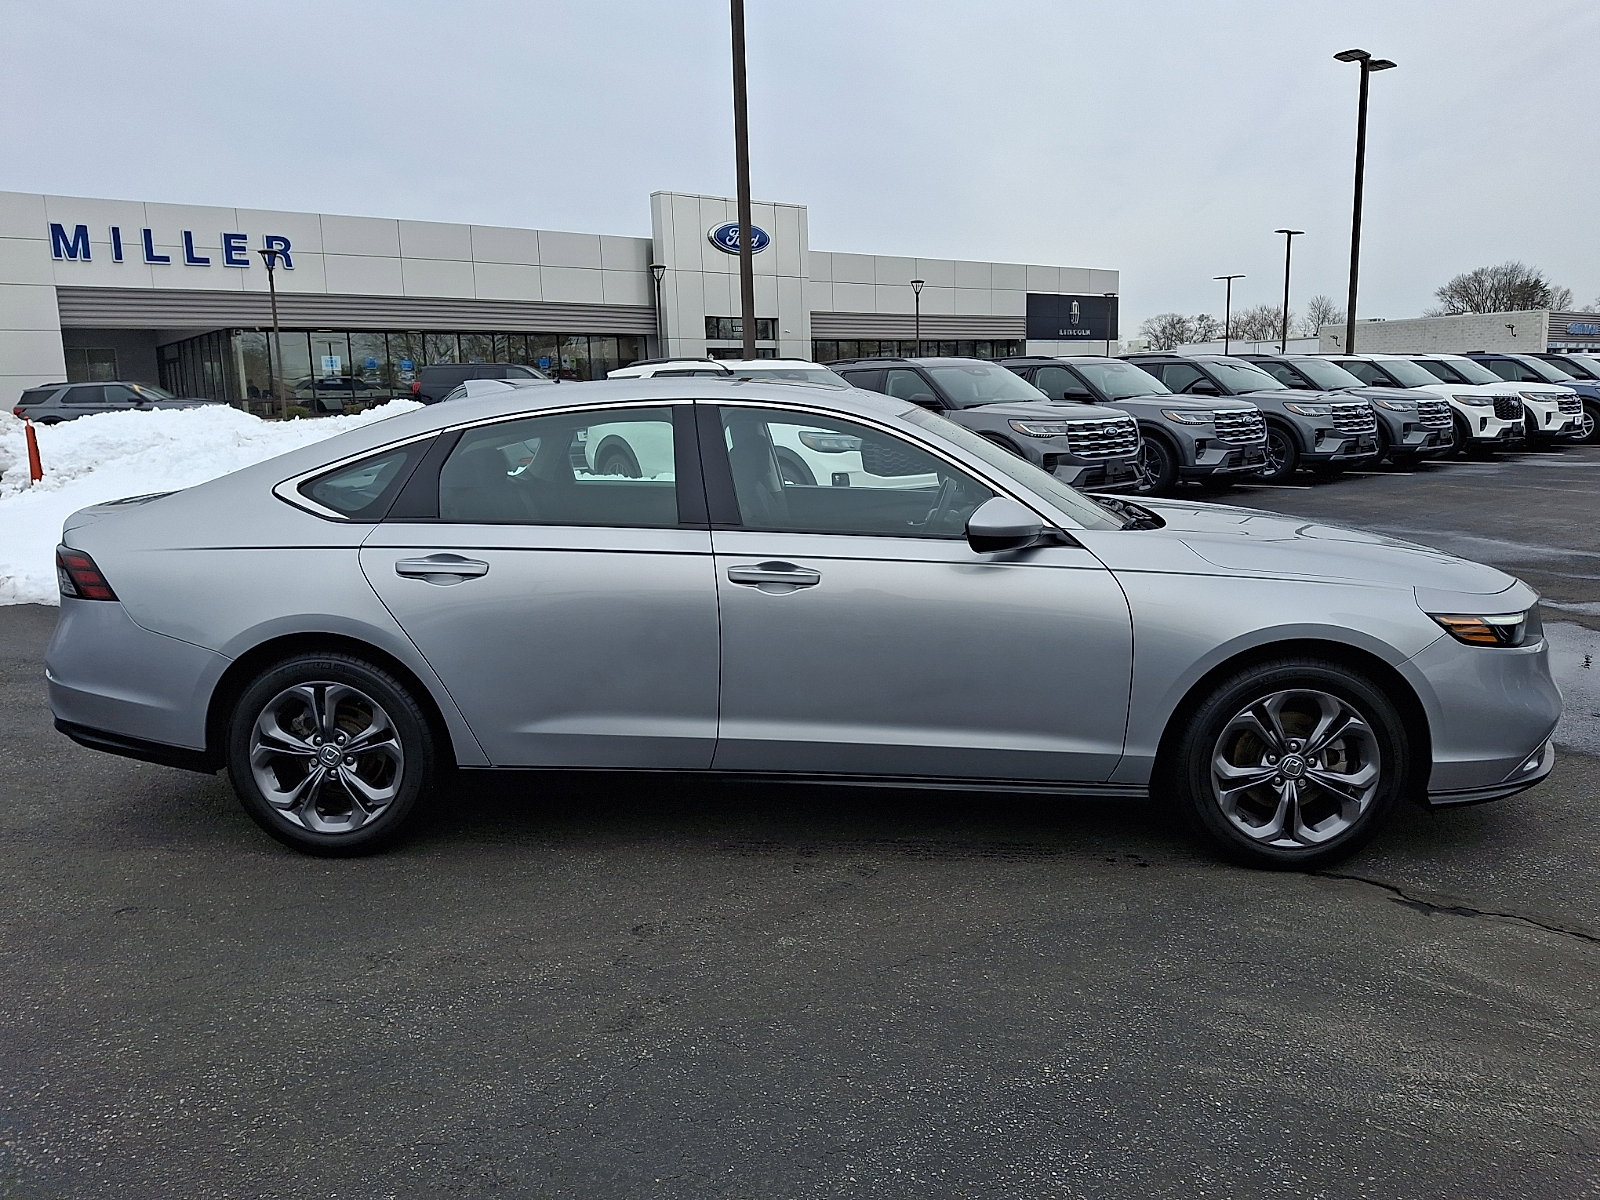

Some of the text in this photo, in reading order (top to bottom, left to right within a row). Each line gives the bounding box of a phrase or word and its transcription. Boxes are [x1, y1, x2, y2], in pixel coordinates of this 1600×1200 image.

[48, 222, 295, 270] MILLER
[725, 227, 760, 247] Fd
[1058, 328, 1091, 336] LINCOLN
